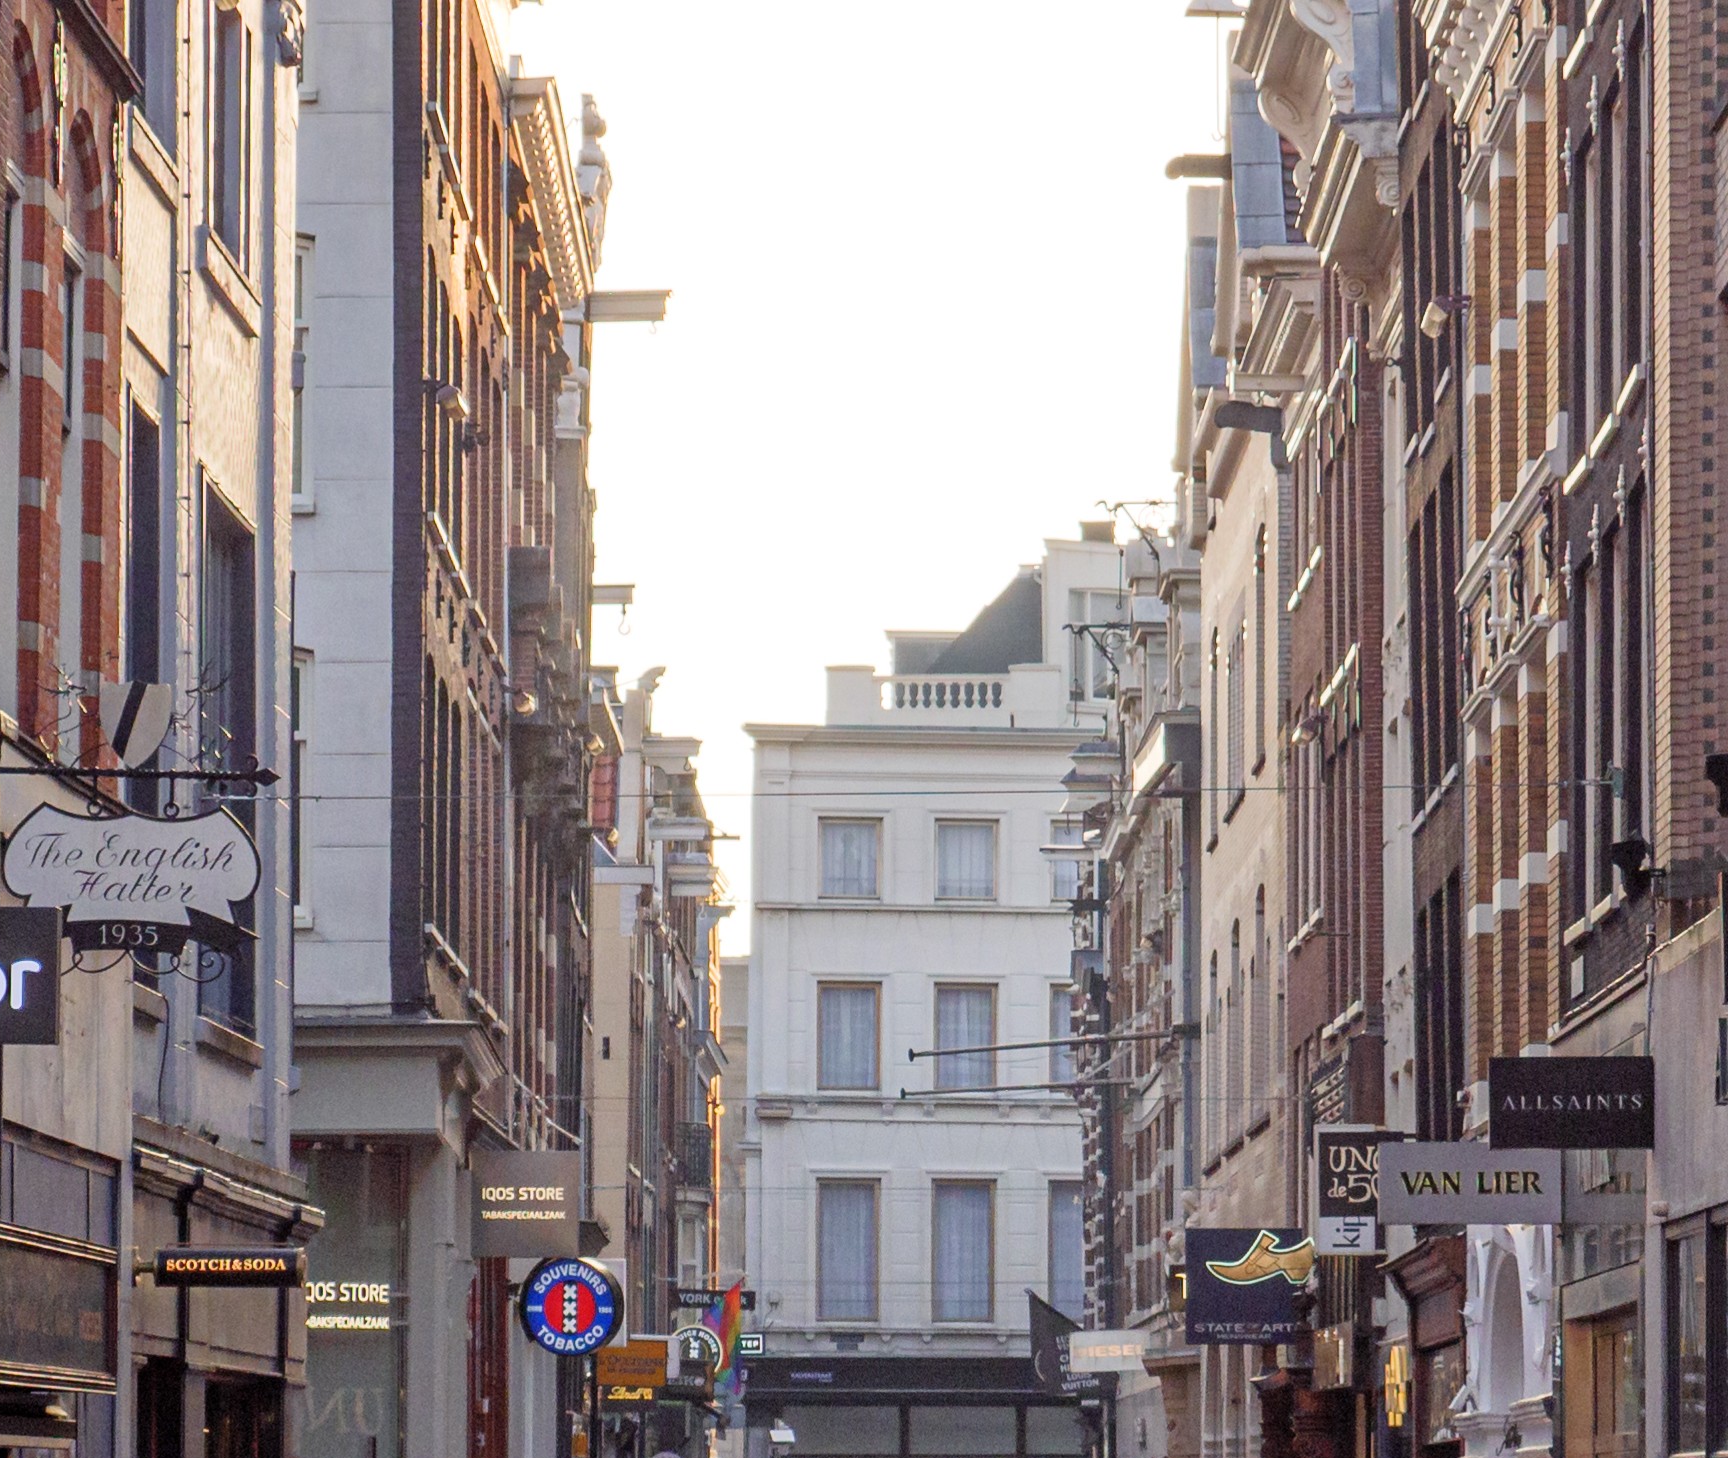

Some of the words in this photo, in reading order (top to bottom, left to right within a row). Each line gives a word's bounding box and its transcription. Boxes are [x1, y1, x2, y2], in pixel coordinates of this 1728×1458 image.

[25, 832, 84, 869] The
[95, 830, 237, 883] English
[67, 870, 196, 903] Hatter
[99, 924, 159, 946] 1935
[1501, 1092, 1645, 1111] ALLSAINTS
[1400, 1171, 1461, 1196] VAN
[1477, 1171, 1544, 1196] LIER
[481, 1186, 515, 1202] IQOS
[518, 1186, 565, 1201] STORE
[480, 1210, 566, 1220] TABAKSPECIAALZAAK
[166, 1258, 287, 1272] SCOTCH&SODA
[533, 1264, 608, 1296] SOUVENIRS
[339, 1282, 391, 1304] STORE
[678, 1292, 710, 1304] YORK
[537, 1324, 605, 1352] TOBACCO
[1194, 1323, 1246, 1333] STATE
[1261, 1323, 1294, 1333] ART
[1061, 1378, 1100, 1391] VUITTON
